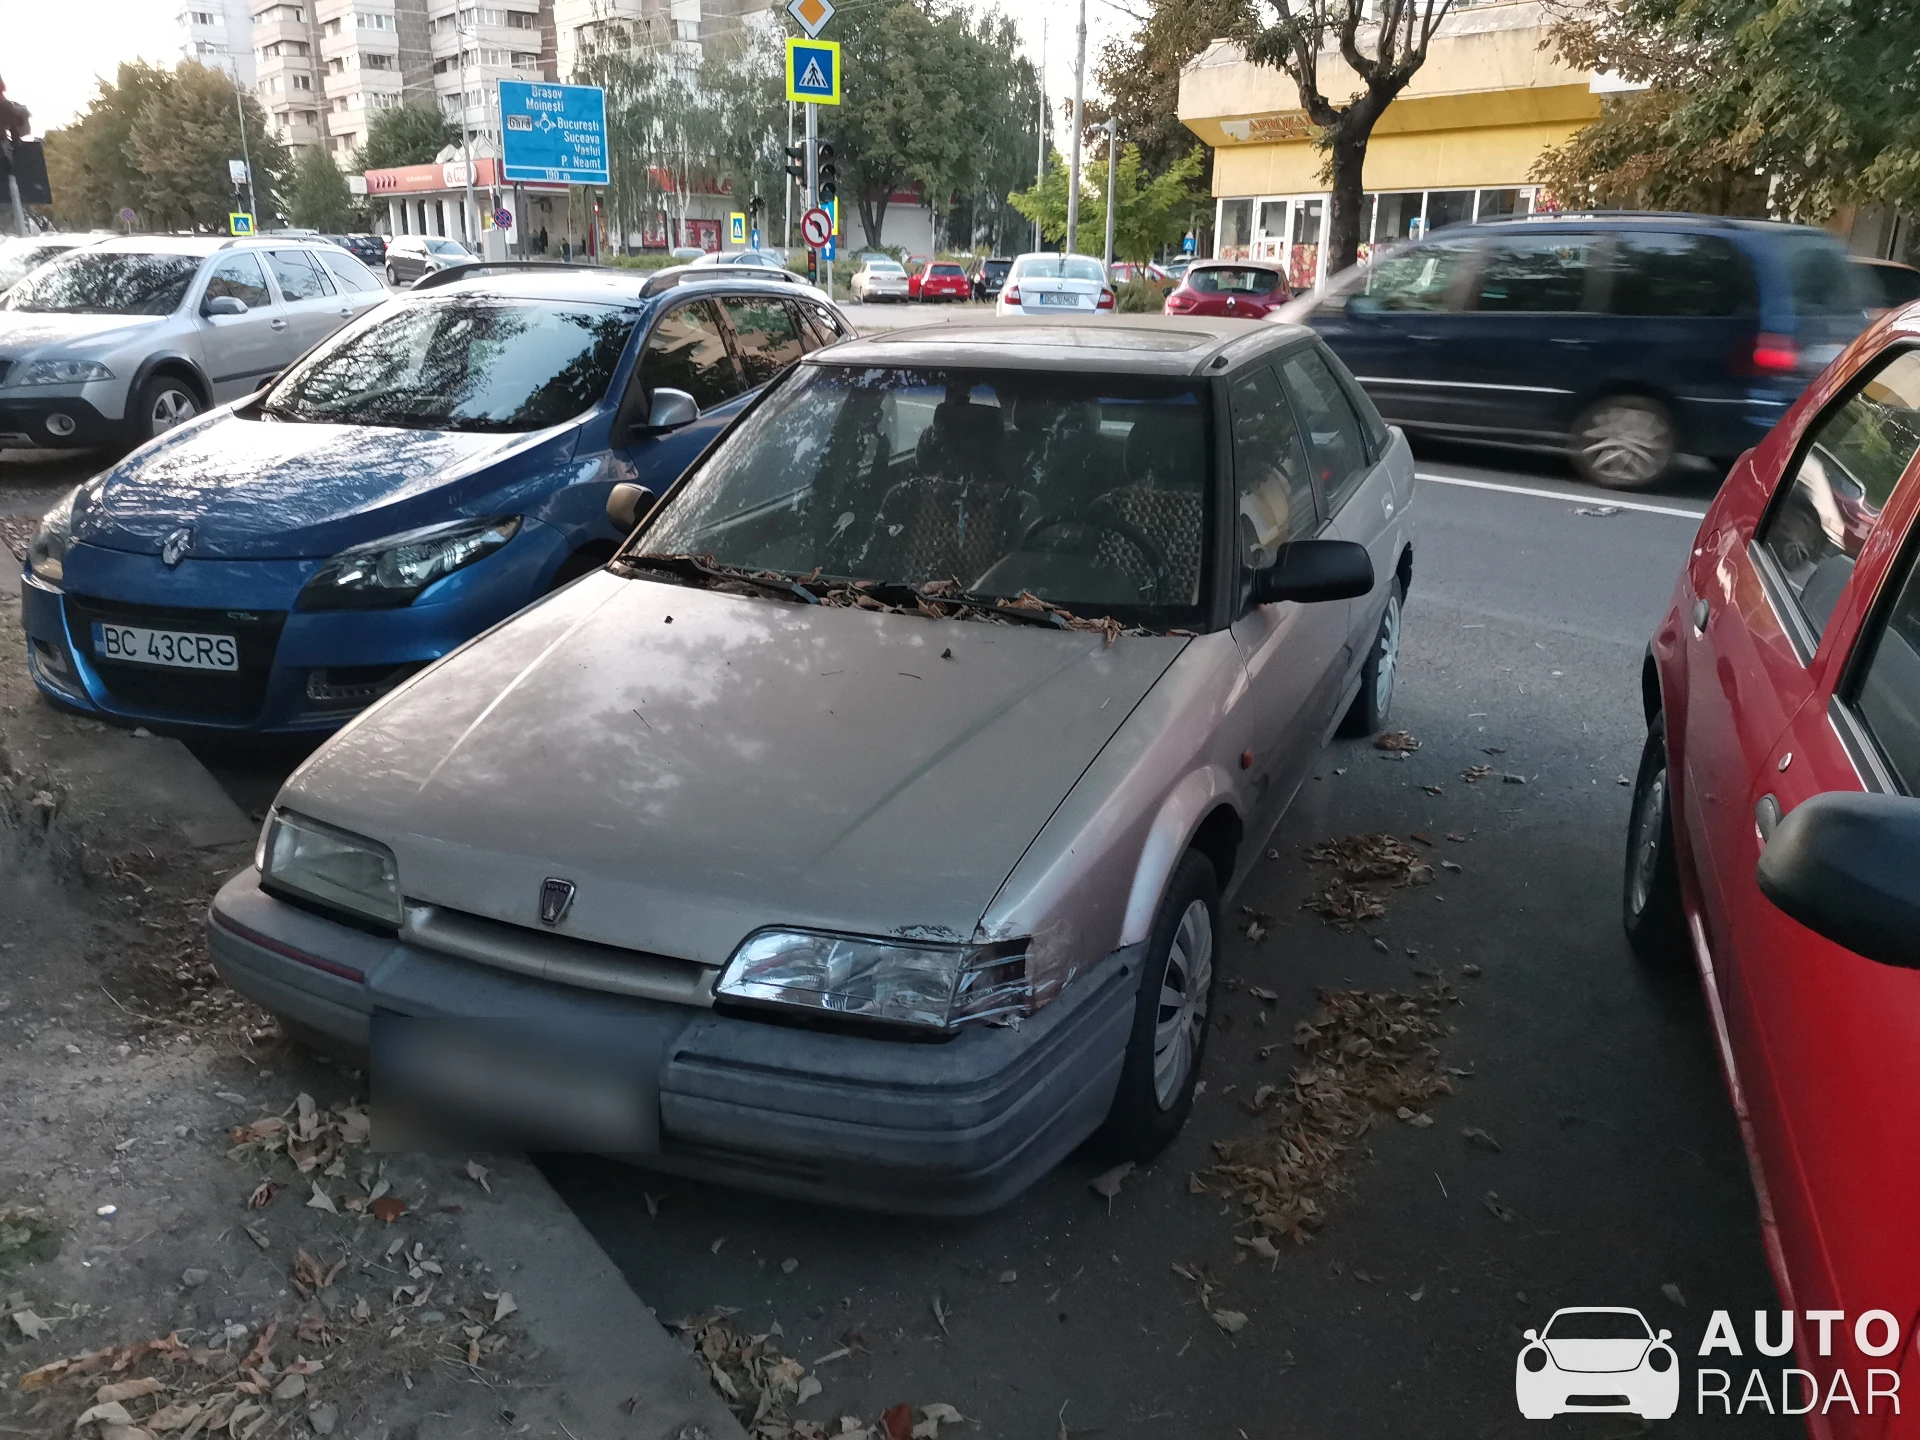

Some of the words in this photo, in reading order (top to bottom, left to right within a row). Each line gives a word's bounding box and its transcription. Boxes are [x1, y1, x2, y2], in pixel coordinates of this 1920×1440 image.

[564, 131, 600, 144] Suceava
[574, 144, 601, 156] Vaslui
[561, 155, 569, 167] P.
[545, 169, 559, 180] 190
[104, 627, 137, 656] BC
[147, 632, 235, 666] 43CRS
